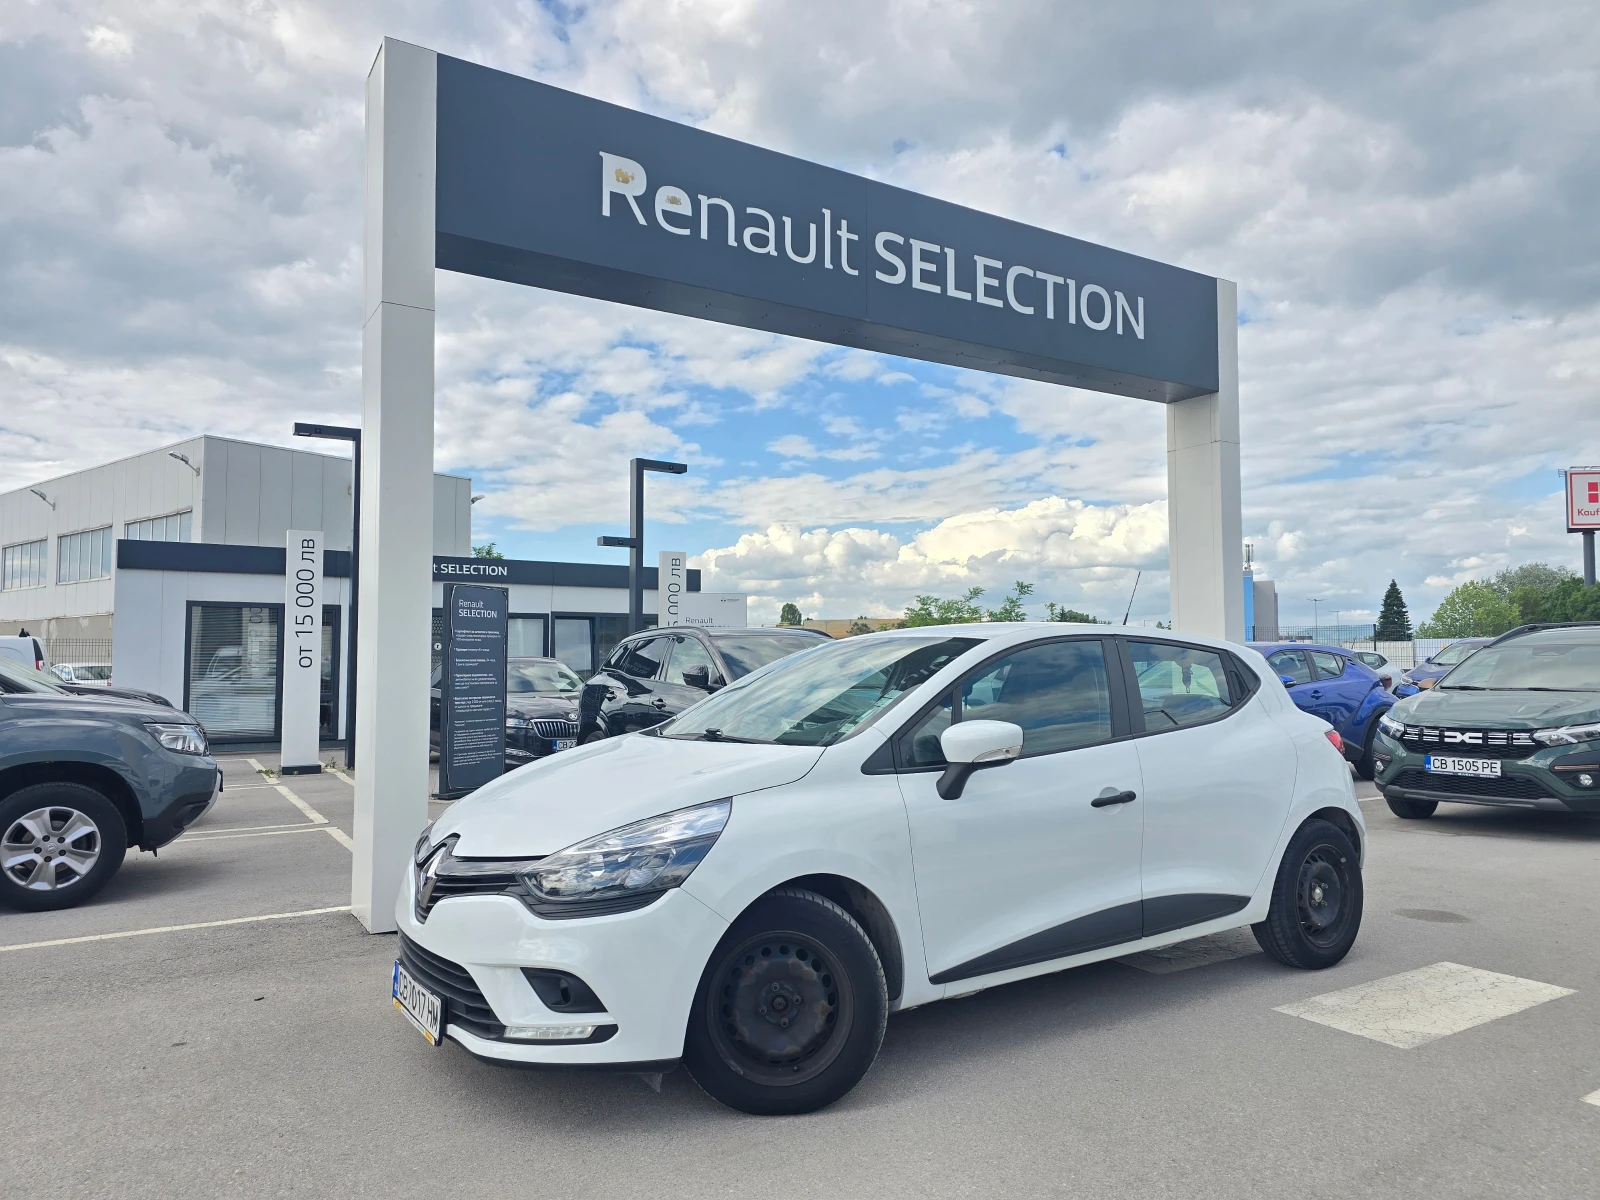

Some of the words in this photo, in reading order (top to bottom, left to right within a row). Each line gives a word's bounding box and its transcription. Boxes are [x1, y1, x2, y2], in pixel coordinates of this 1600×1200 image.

[598, 151, 859, 277] Renault
[874, 231, 1145, 340] SELECTION
[440, 563, 508, 576] SELECTION
[295, 569, 315, 608] 000
[458, 599, 484, 609] Renault
[458, 609, 498, 618] SELECTION
[295, 615, 314, 638] 15
[1432, 758, 1448, 770] CB
[1451, 759, 1479, 772] 1505
[1481, 761, 1499, 774] PE
